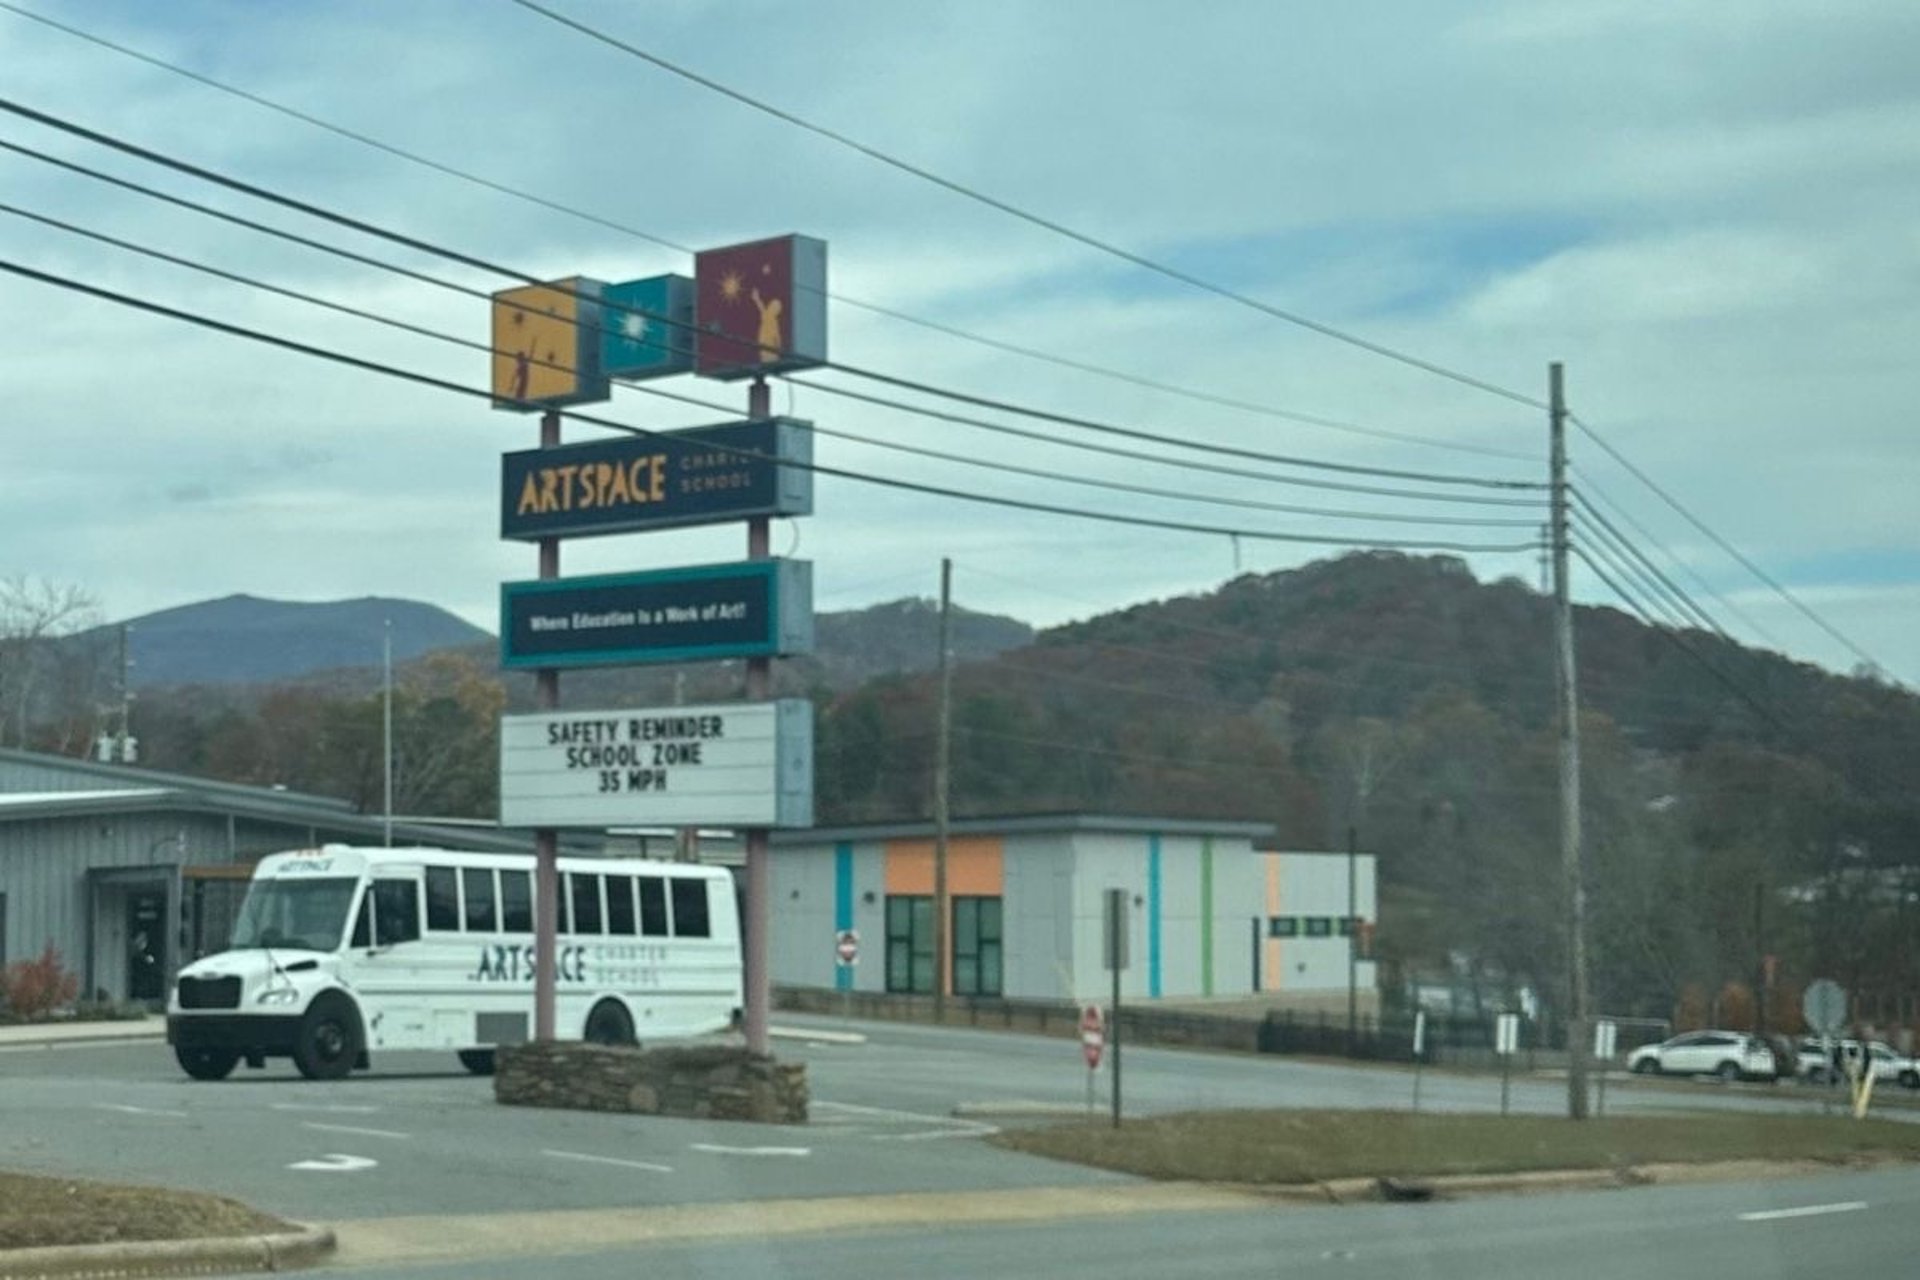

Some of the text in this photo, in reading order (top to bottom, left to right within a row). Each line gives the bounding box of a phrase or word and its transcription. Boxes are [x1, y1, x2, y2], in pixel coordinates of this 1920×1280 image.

[518, 455, 667, 514] ARTSPACE
[681, 471, 752, 493] SCHOOL
[531, 615, 568, 632] Where
[572, 611, 634, 630] Education
[655, 610, 663, 624] a
[666, 604, 698, 623] Work
[702, 603, 717, 621] of
[548, 715, 723, 745] SAFETY REMINDER
[567, 742, 702, 768] SCHOOL ZONE
[599, 769, 667, 793] 35 MPH
[476, 945, 586, 982] ARTSCE
